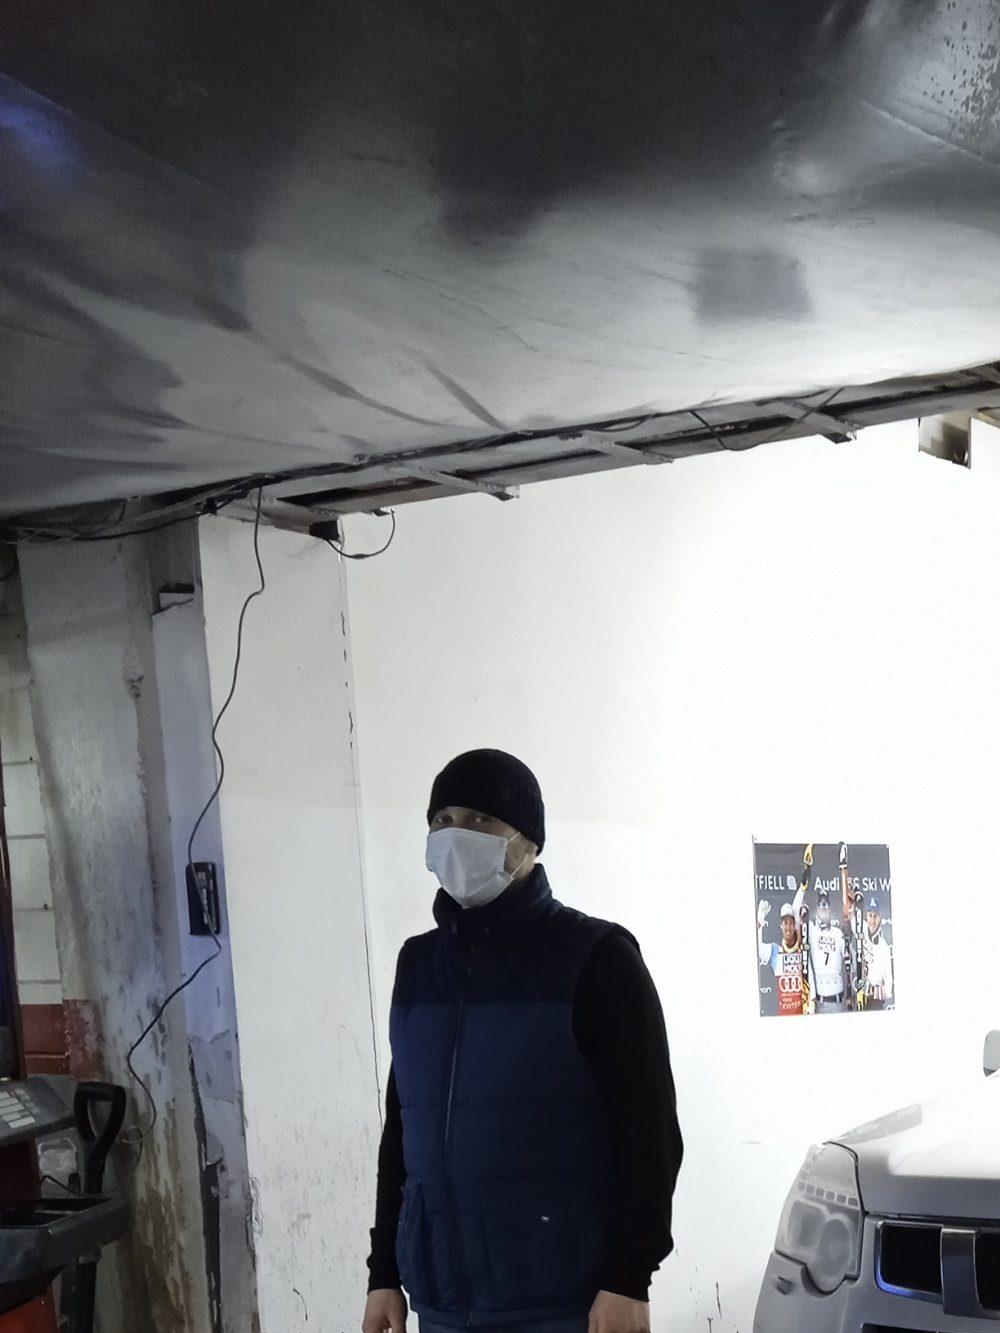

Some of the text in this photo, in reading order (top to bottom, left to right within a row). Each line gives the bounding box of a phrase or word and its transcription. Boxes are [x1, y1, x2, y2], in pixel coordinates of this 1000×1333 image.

[814, 876, 840, 891] Audi
[862, 876, 877, 891] Ski
[824, 952, 829, 966] 7
